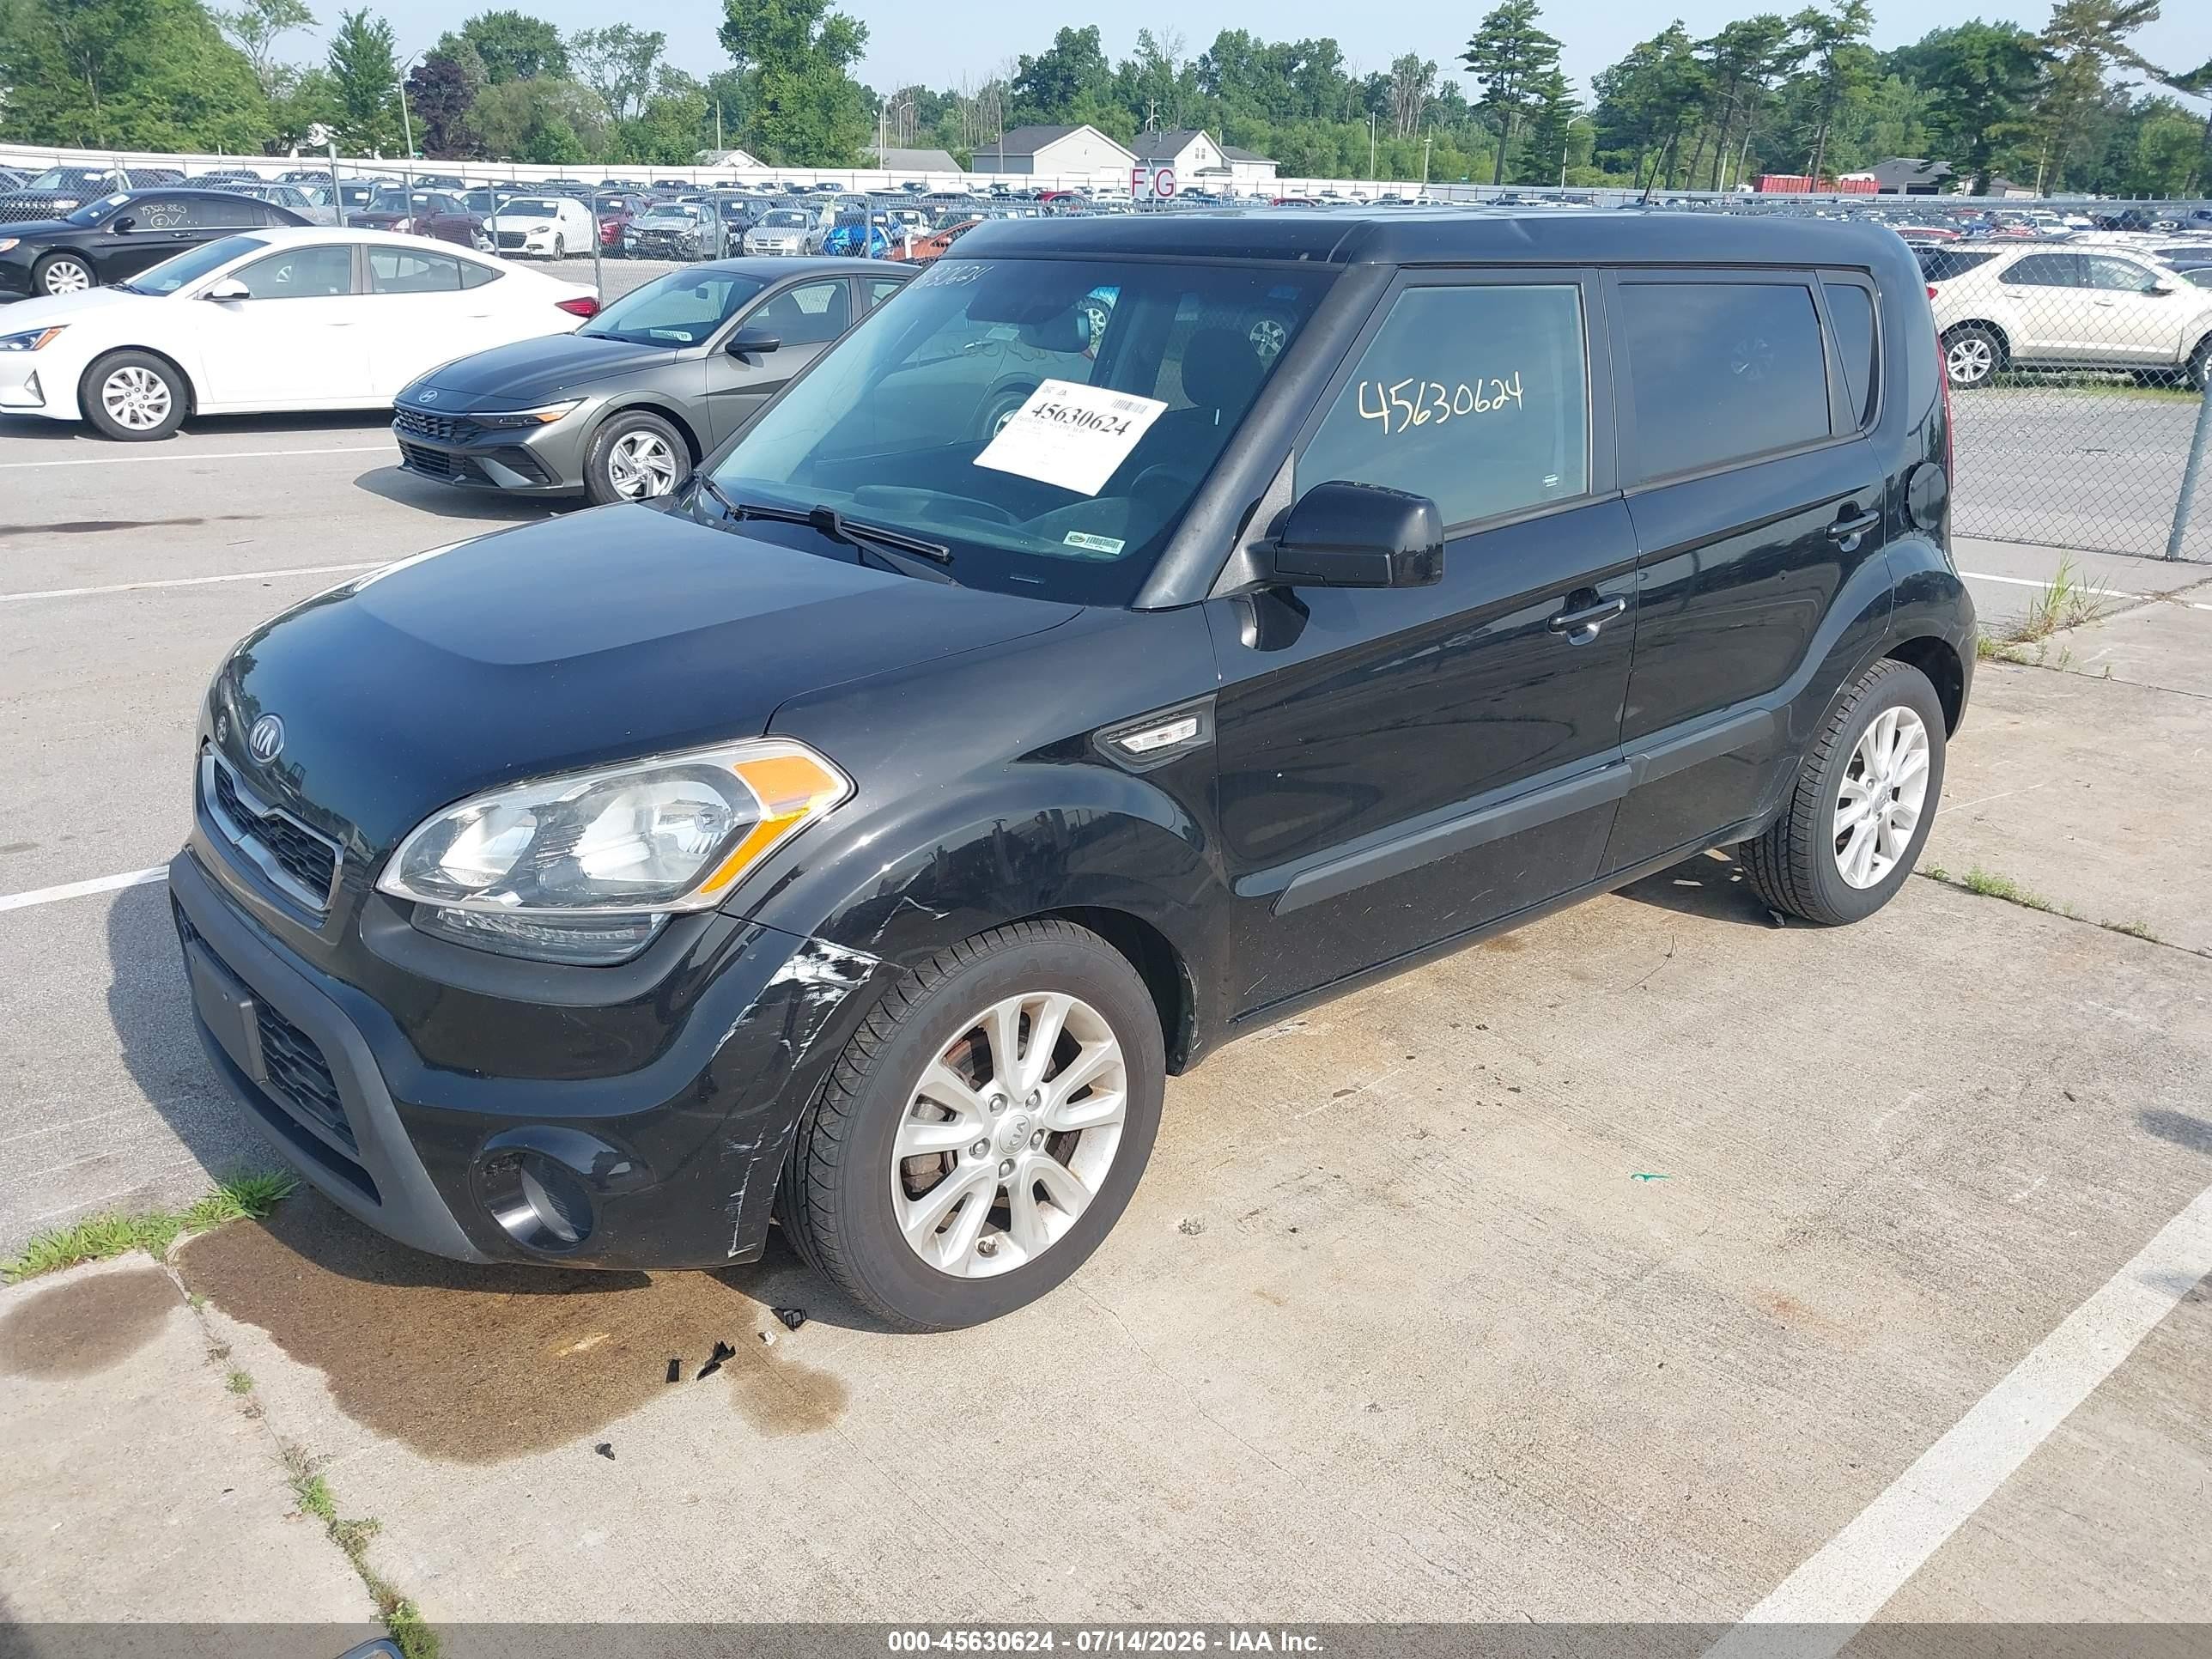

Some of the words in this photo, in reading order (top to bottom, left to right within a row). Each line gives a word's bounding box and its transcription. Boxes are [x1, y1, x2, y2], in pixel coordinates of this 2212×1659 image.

[1132, 168, 1146, 197] F
[1156, 168, 1175, 197] G
[1031, 402, 1132, 436] 45630624
[1358, 370, 1524, 434] 45630624
[251, 720, 276, 757] KIA
[1008, 1121, 1026, 1148] KIA
